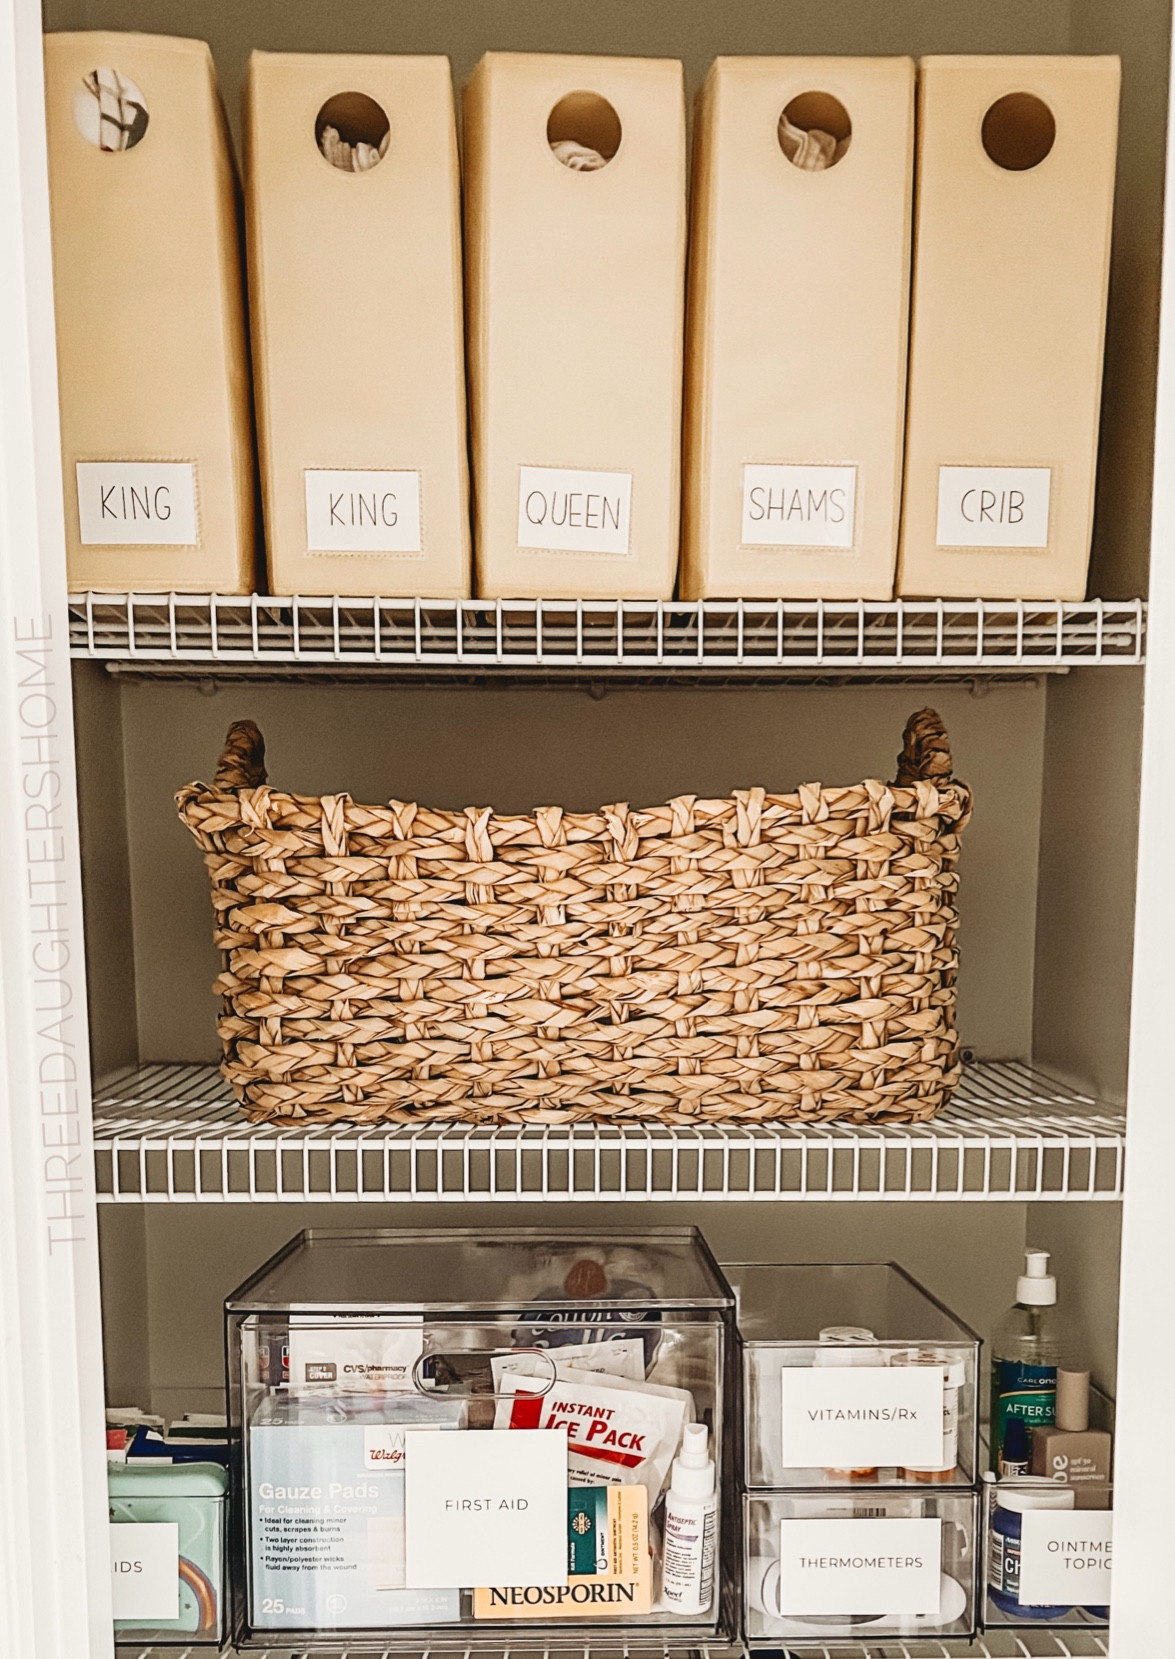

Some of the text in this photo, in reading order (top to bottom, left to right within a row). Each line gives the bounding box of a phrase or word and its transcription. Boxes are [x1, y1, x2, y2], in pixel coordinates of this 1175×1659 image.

[101, 485, 172, 521] KING
[329, 492, 399, 527] KING
[525, 490, 620, 530] QUEEN
[749, 486, 847, 523] SHAMS
[960, 489, 1025, 524] CRIB
[343, 1364, 407, 1374] CVS/pharmacy
[551, 1401, 616, 1421] INSTANT
[807, 1408, 918, 1422] VITAMINS/Rx
[1006, 1403, 1043, 1417] AFTER
[585, 1419, 646, 1451] PACK
[1070, 1465, 1096, 1473] mineral
[258, 1482, 379, 1500] Gauze Pads
[258, 1505, 276, 1514] For
[277, 1504, 321, 1515] Cleaning
[333, 1504, 378, 1515] Covering
[445, 1498, 529, 1512] FIRST AID
[294, 1517, 325, 1525] cleaning
[666, 1520, 682, 1533] SPRAY
[272, 1545, 293, 1553] highly
[1047, 1541, 1112, 1553] OINTME
[265, 1555, 322, 1564] Rayon/polyester
[799, 1557, 924, 1569] THERMOMETERS
[114, 1561, 143, 1573] IDS
[489, 1582, 636, 1606] NEOSPORIN
[262, 1598, 306, 1615] 25 PADS
